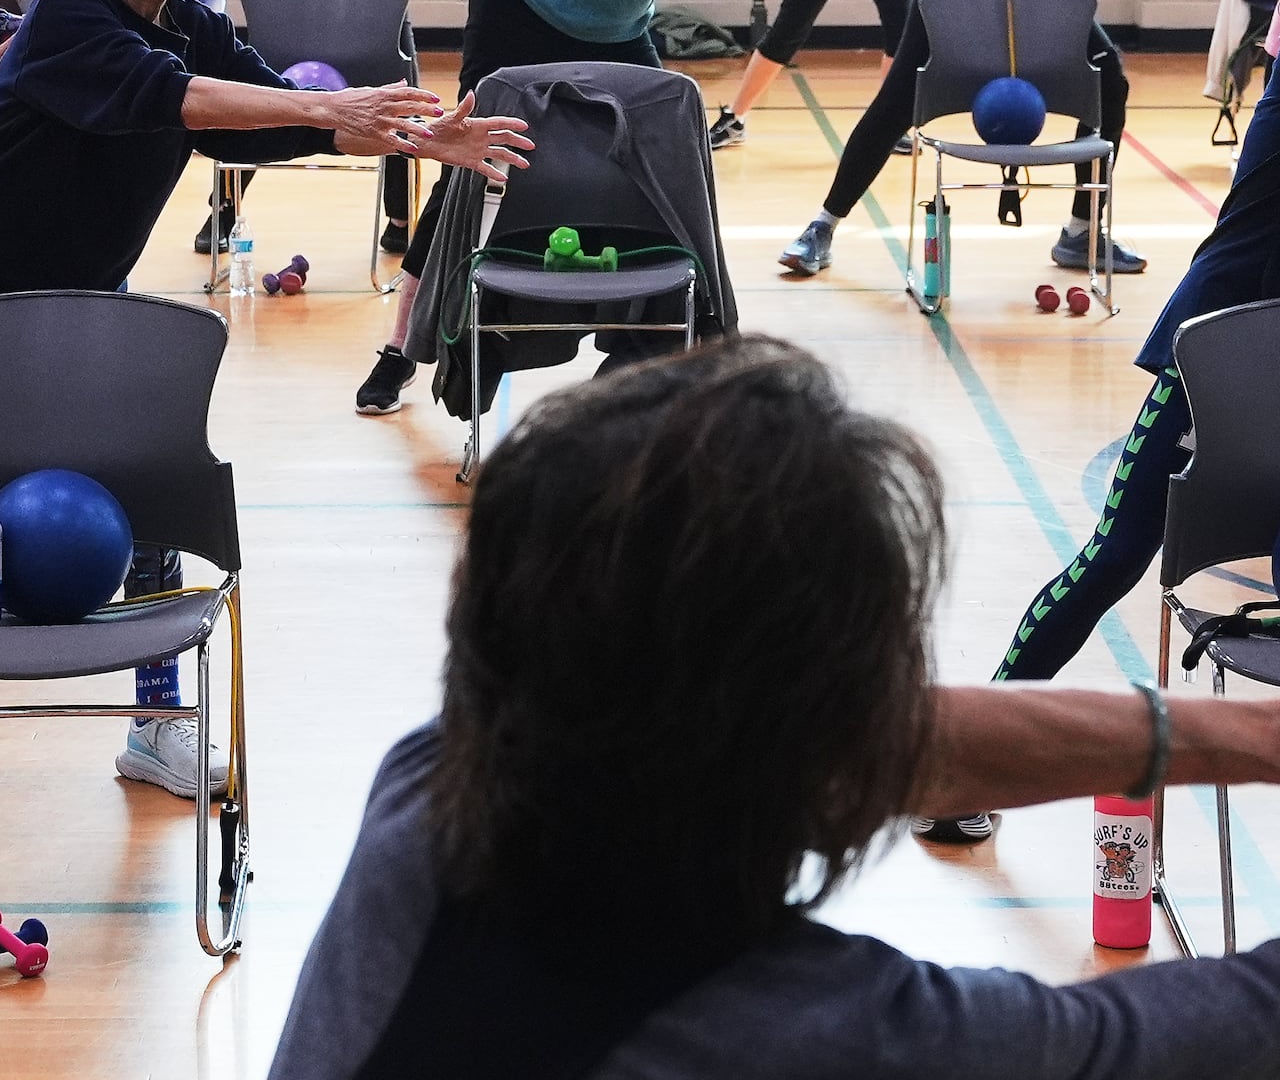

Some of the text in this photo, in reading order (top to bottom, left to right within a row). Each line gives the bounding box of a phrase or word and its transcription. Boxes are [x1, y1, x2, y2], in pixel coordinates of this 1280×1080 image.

[137, 676, 169, 688] BAMA
[1094, 824, 1149, 850] SURF'S UP
